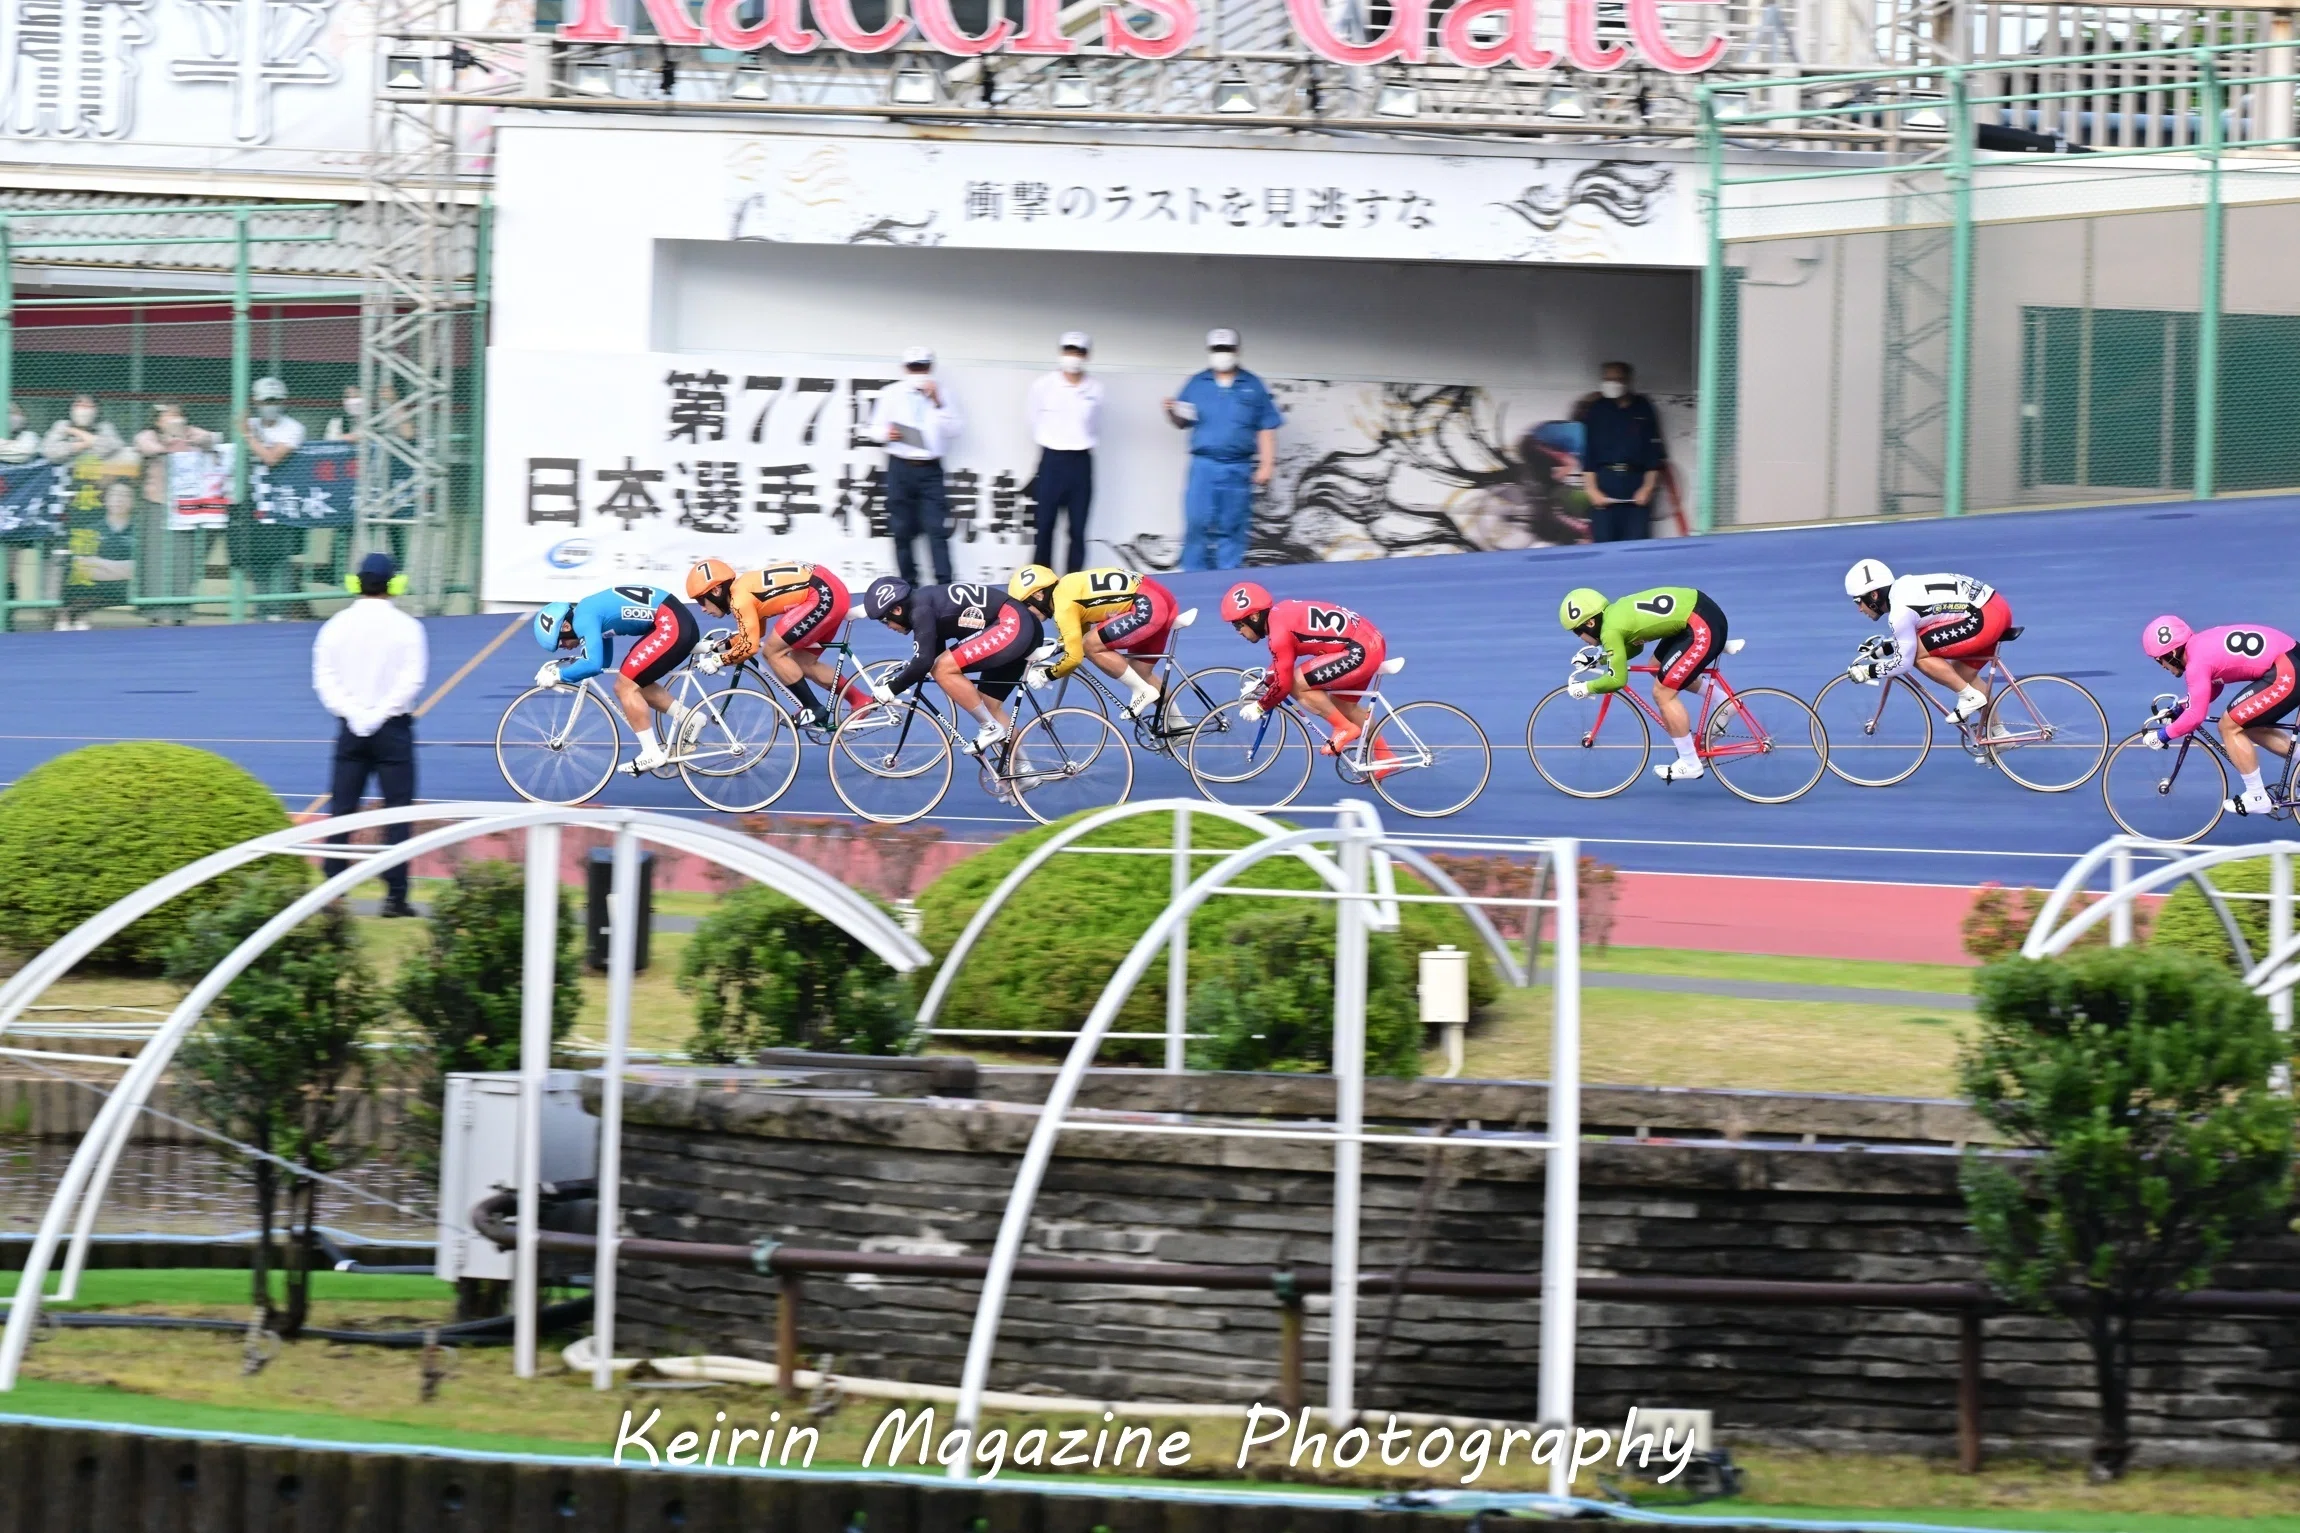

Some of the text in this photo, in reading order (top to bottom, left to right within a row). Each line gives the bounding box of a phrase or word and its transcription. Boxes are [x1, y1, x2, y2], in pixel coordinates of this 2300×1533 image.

[964, 181, 1437, 229] 衝撃のラストを見逃すな
[696, 561, 713, 582] 7
[761, 566, 800, 588] 7
[1020, 568, 1036, 587] 5
[1089, 571, 1131, 592] 5
[1863, 565, 1874, 585] 1
[612, 586, 655, 607] 4
[876, 584, 896, 609] 2
[948, 583, 987, 607] 2
[1233, 588, 1251, 610] 3
[1925, 582, 1958, 595] 1
[1567, 599, 1582, 620] 6
[1635, 594, 1676, 617] 6
[539, 613, 554, 633] 4
[1308, 606, 1348, 636] 3
[2157, 625, 2173, 645] 8
[2225, 630, 2266, 659] 8
[763, 671, 802, 709] BRIDGESTON
[827, 661, 843, 711] BRIDGESTONE
[1086, 672, 1126, 711] BRIDGESTO
